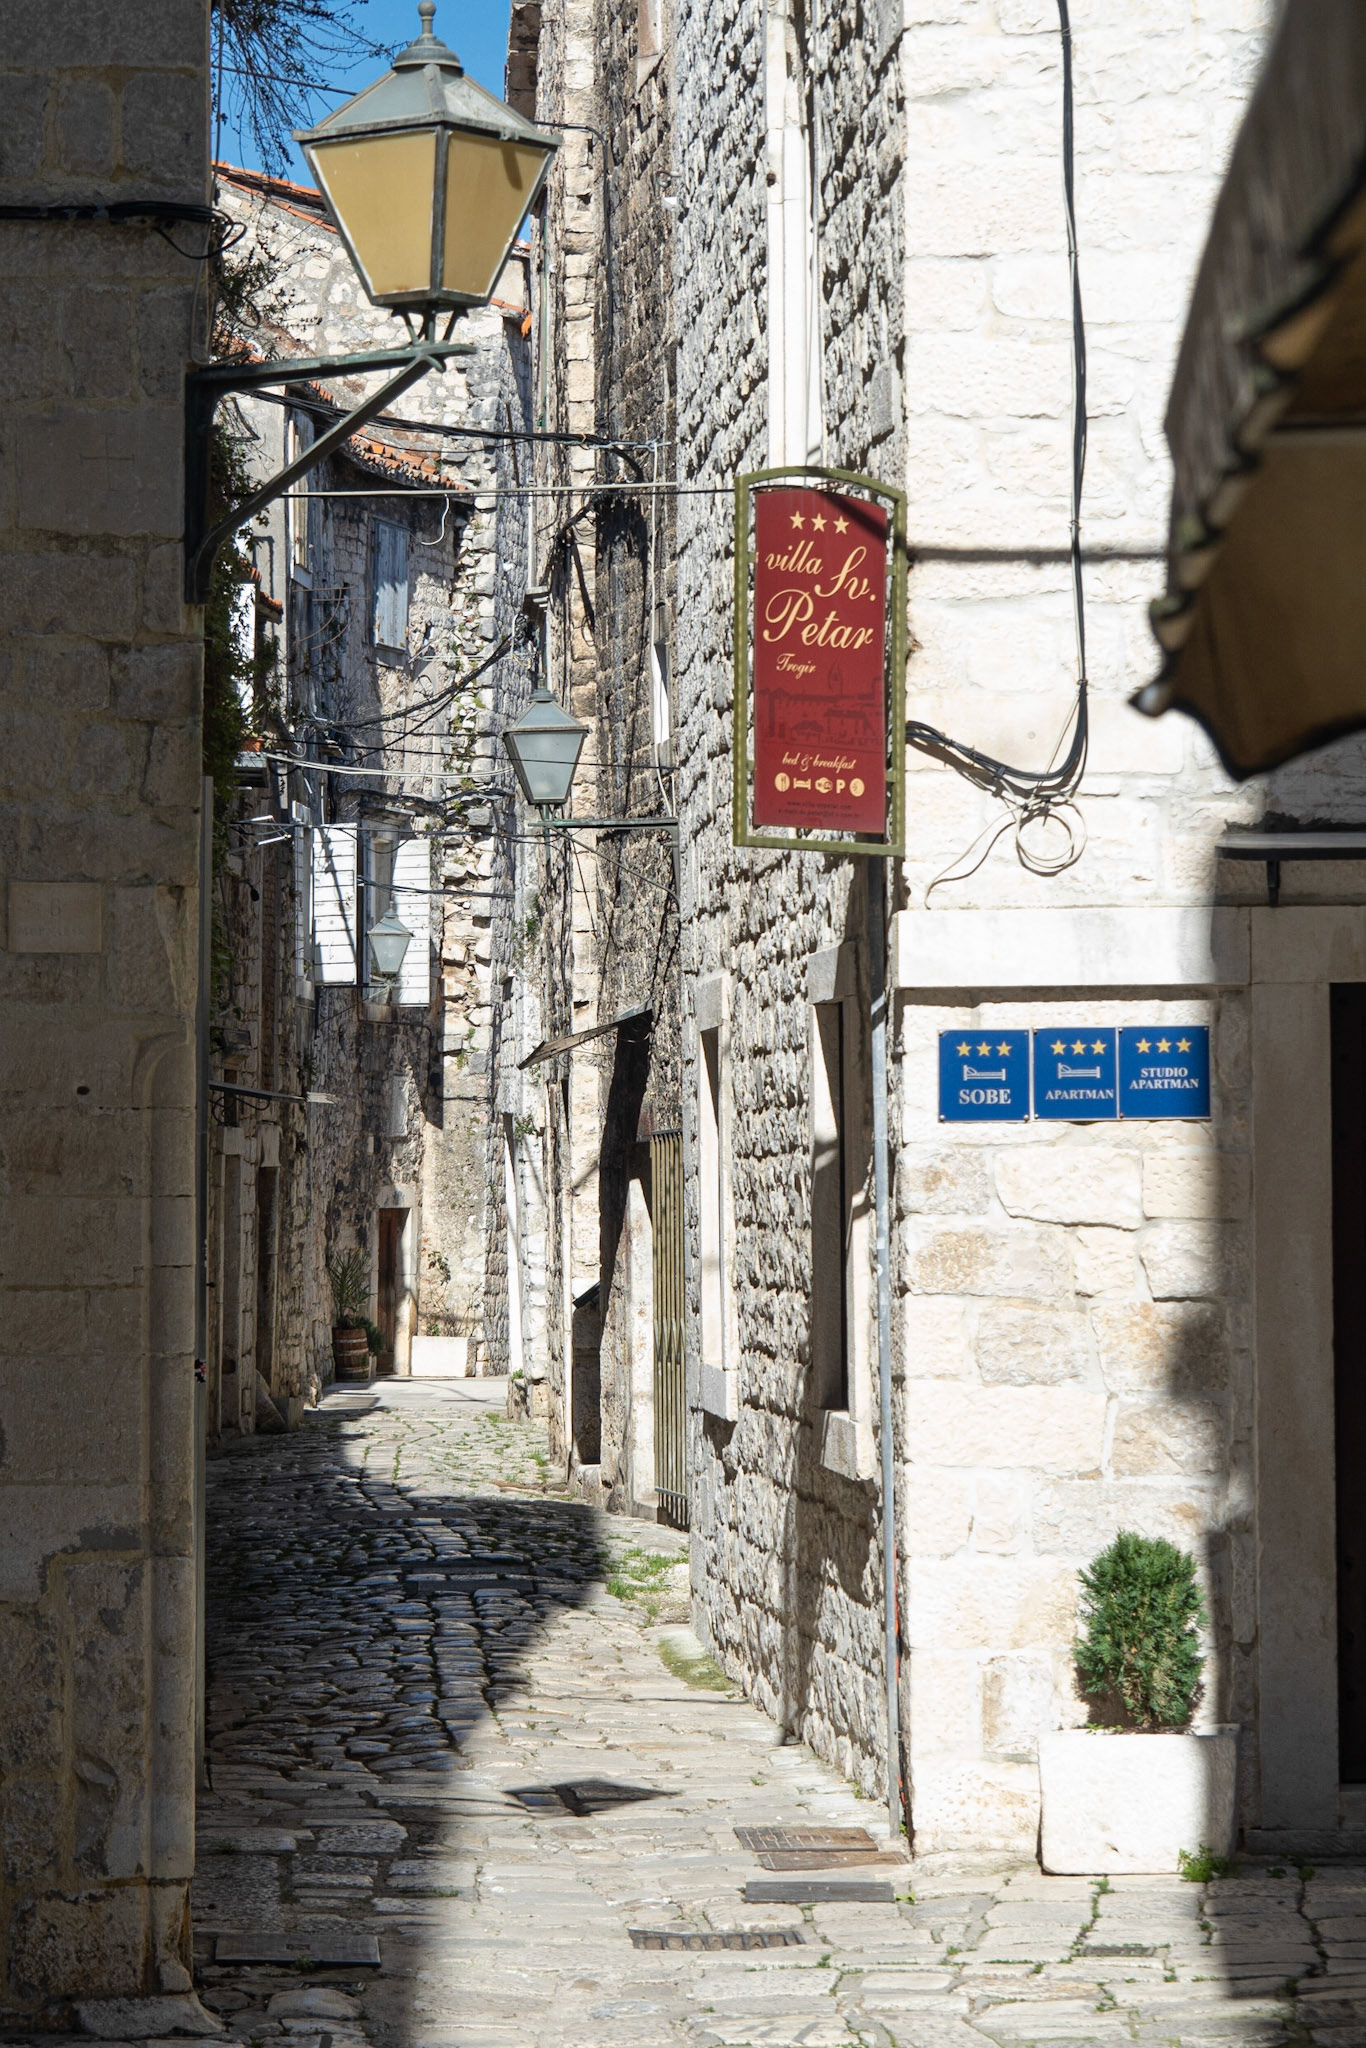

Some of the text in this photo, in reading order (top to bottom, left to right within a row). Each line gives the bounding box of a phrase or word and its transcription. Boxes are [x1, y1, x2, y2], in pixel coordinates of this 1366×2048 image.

[764, 540, 824, 575] villa
[814, 546, 876, 602] Sv.
[763, 588, 874, 649] Petar
[776, 652, 816, 679] Trogir
[782, 752, 801, 766] bed
[812, 754, 857, 774] breakfast
[1140, 1067, 1189, 1078] STUDIO
[1045, 1088, 1115, 1100] APARTMAN
[1129, 1078, 1200, 1090] APARTMAN
[958, 1088, 1012, 1105] SOBE
